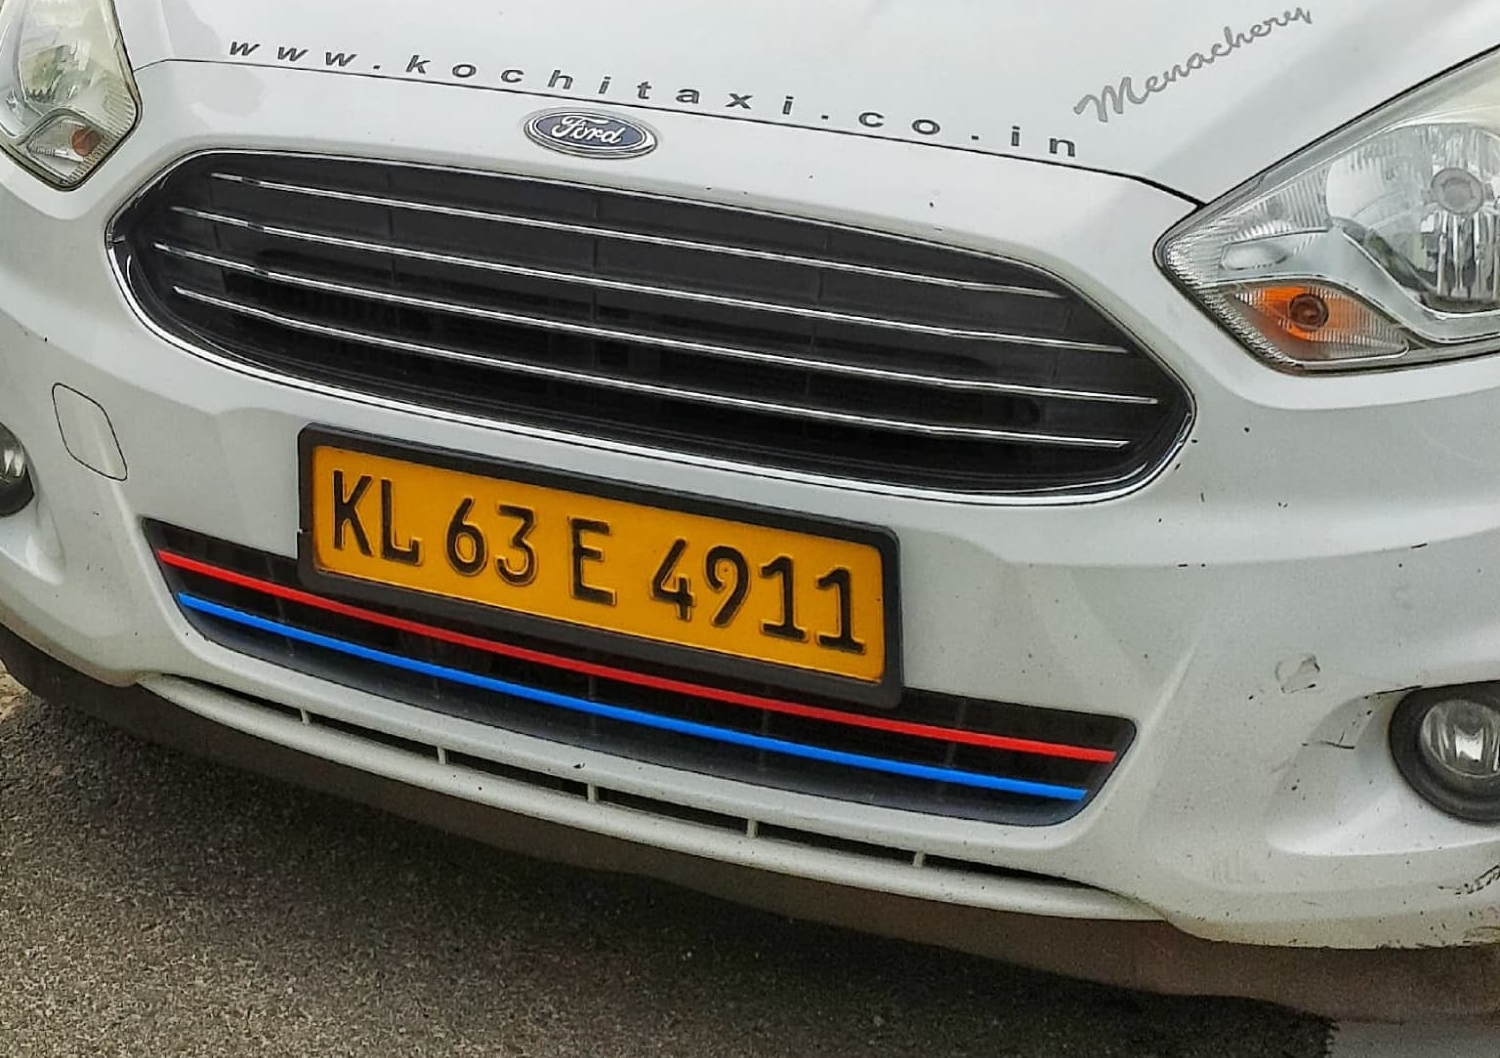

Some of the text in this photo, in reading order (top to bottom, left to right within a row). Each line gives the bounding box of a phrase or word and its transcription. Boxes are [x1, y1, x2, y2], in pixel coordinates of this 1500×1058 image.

[229, 40, 1077, 158] www.kochitaxi.co.in
[551, 115, 626, 144] Ford
[331, 468, 867, 655] KL 63 E 4911
